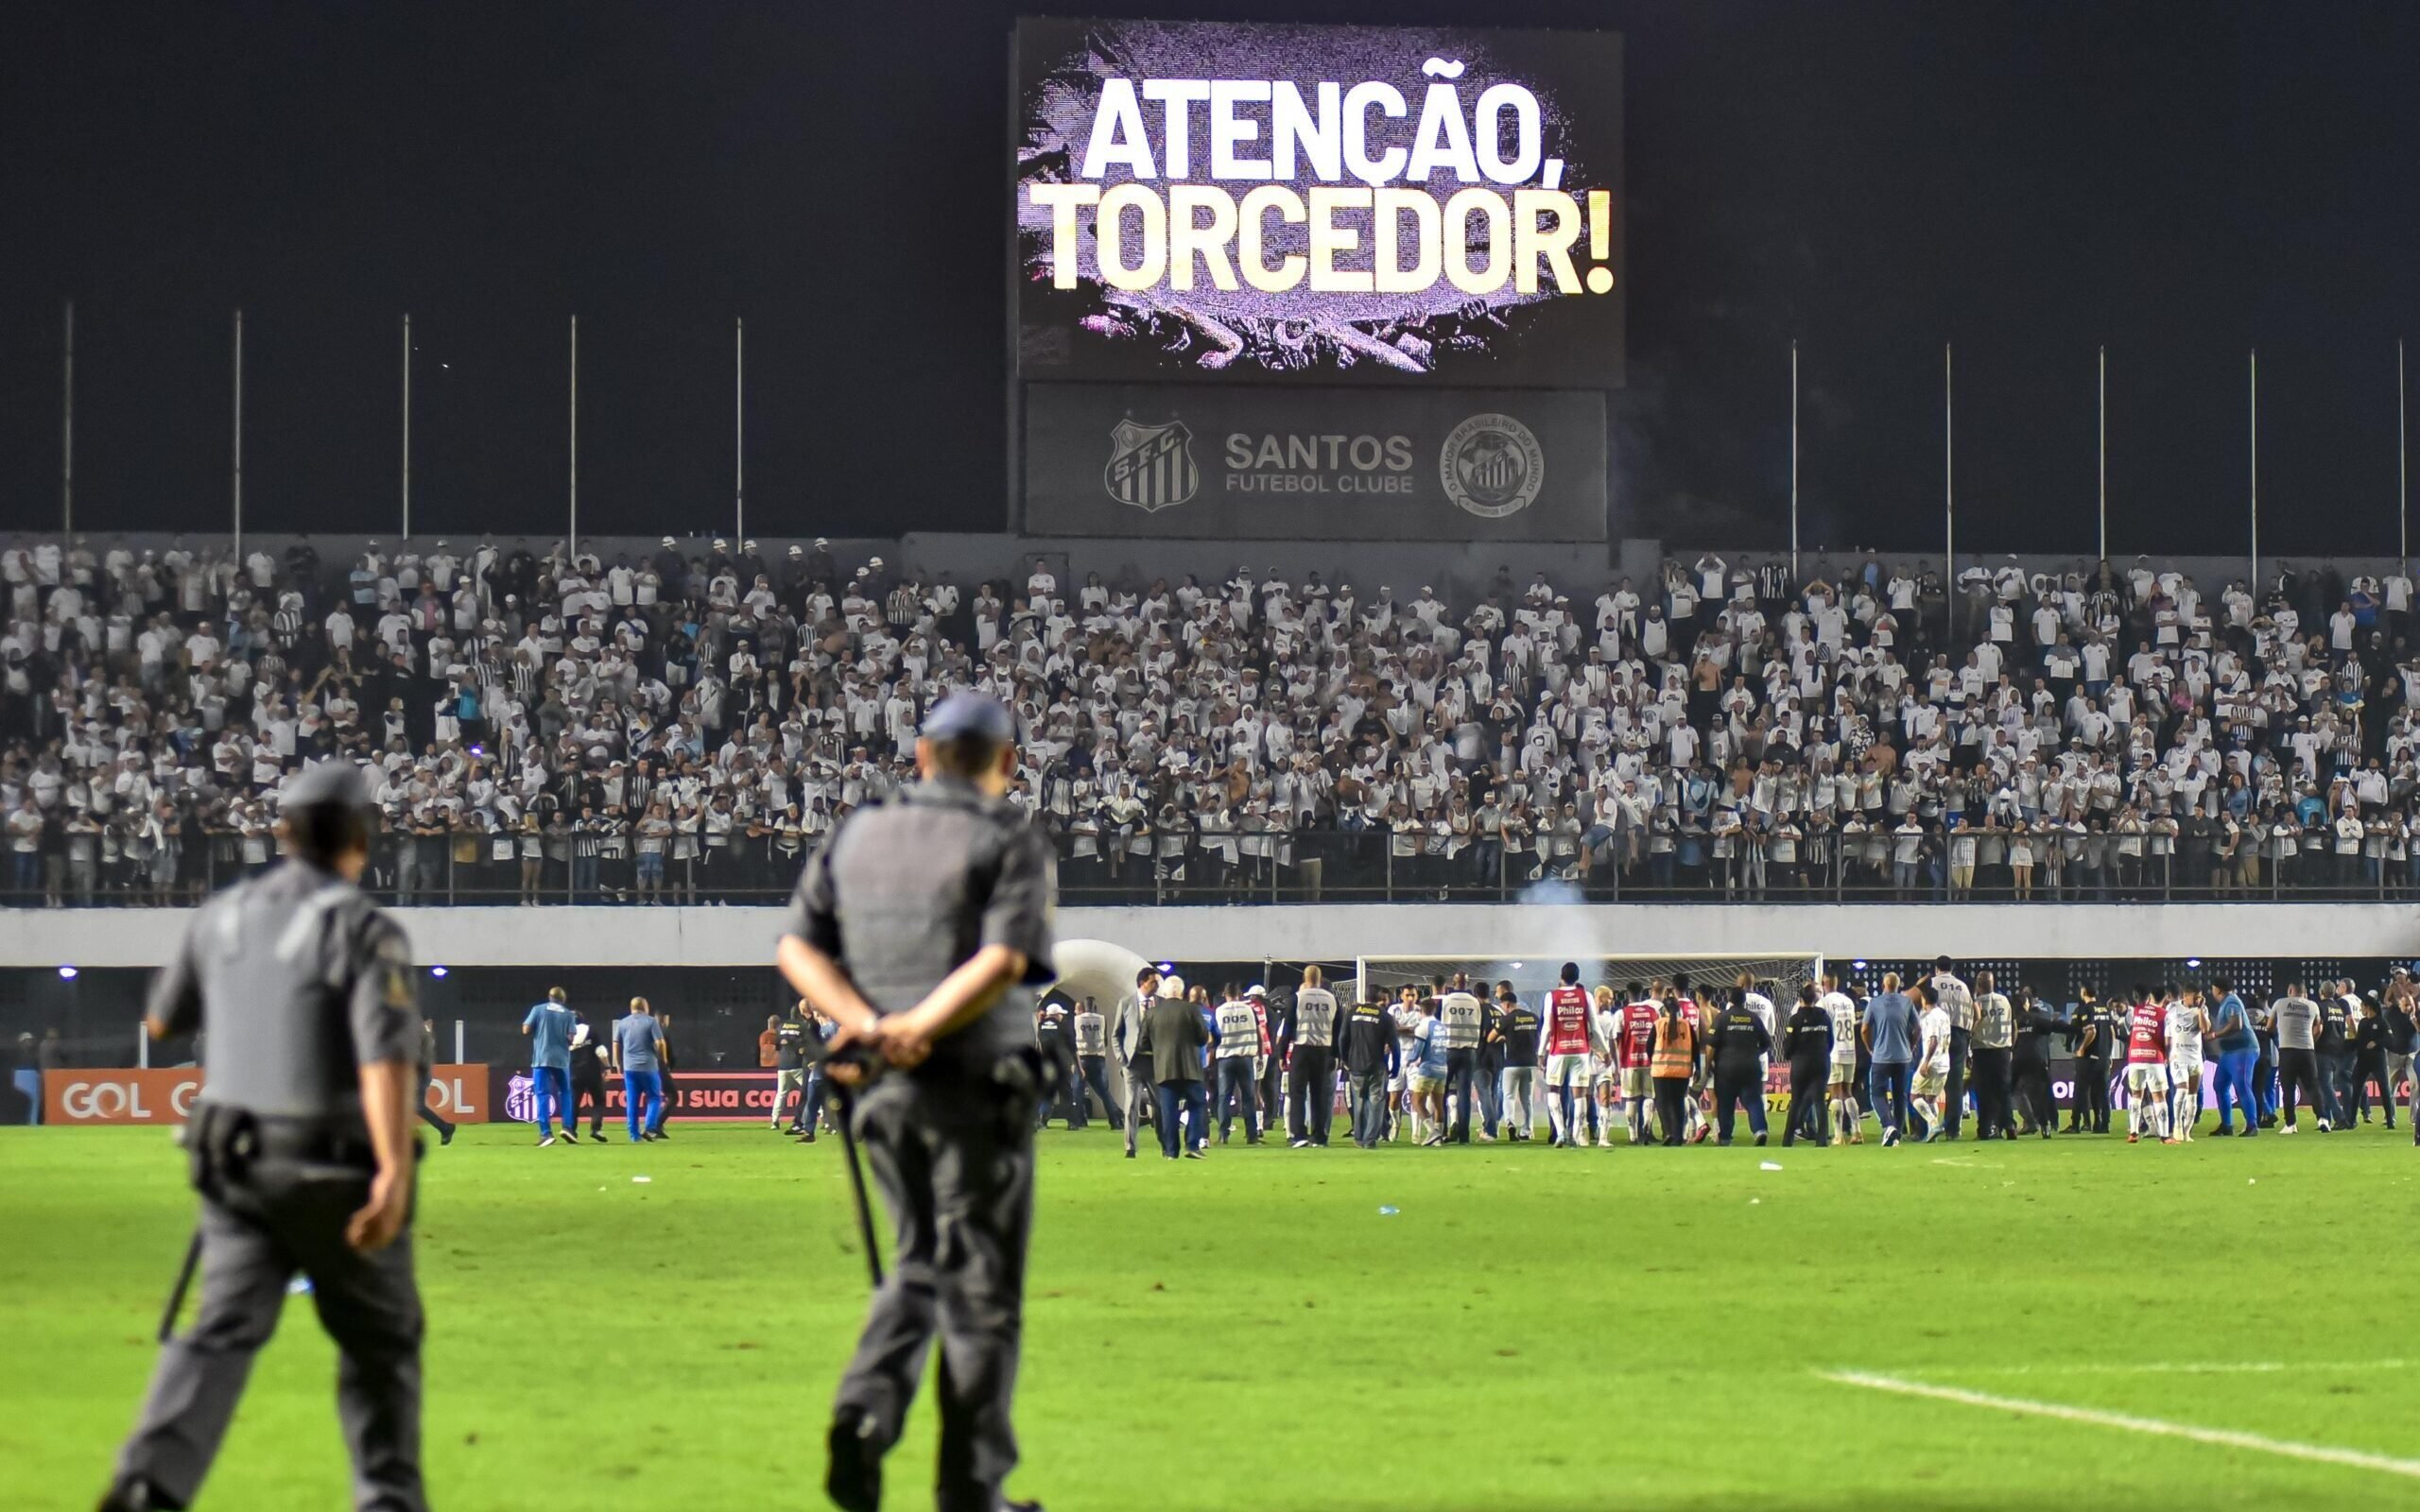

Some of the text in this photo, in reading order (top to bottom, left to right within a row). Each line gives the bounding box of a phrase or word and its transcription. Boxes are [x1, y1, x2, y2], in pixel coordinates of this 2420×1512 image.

[1081, 58, 1564, 190] ATENÇÃO,
[1029, 183, 1614, 295] TORCEDOR!
[1456, 418, 1517, 442] BRASILEIRO
[1225, 433, 1413, 472] SANTOS
[1226, 473, 1414, 494] FUTEBOL CLUBE
[1940, 982, 1963, 992] 014
[1305, 1003, 1330, 1012] 013
[1448, 1006, 1475, 1017] 007
[1557, 1005, 1584, 1016] Philco
[1221, 1014, 1249, 1024] 005
[2134, 1016, 2158, 1028] Philco
[1836, 1019, 1854, 1042] 28
[63, 1082, 151, 1119] GOL
[689, 1090, 739, 1108] sua
